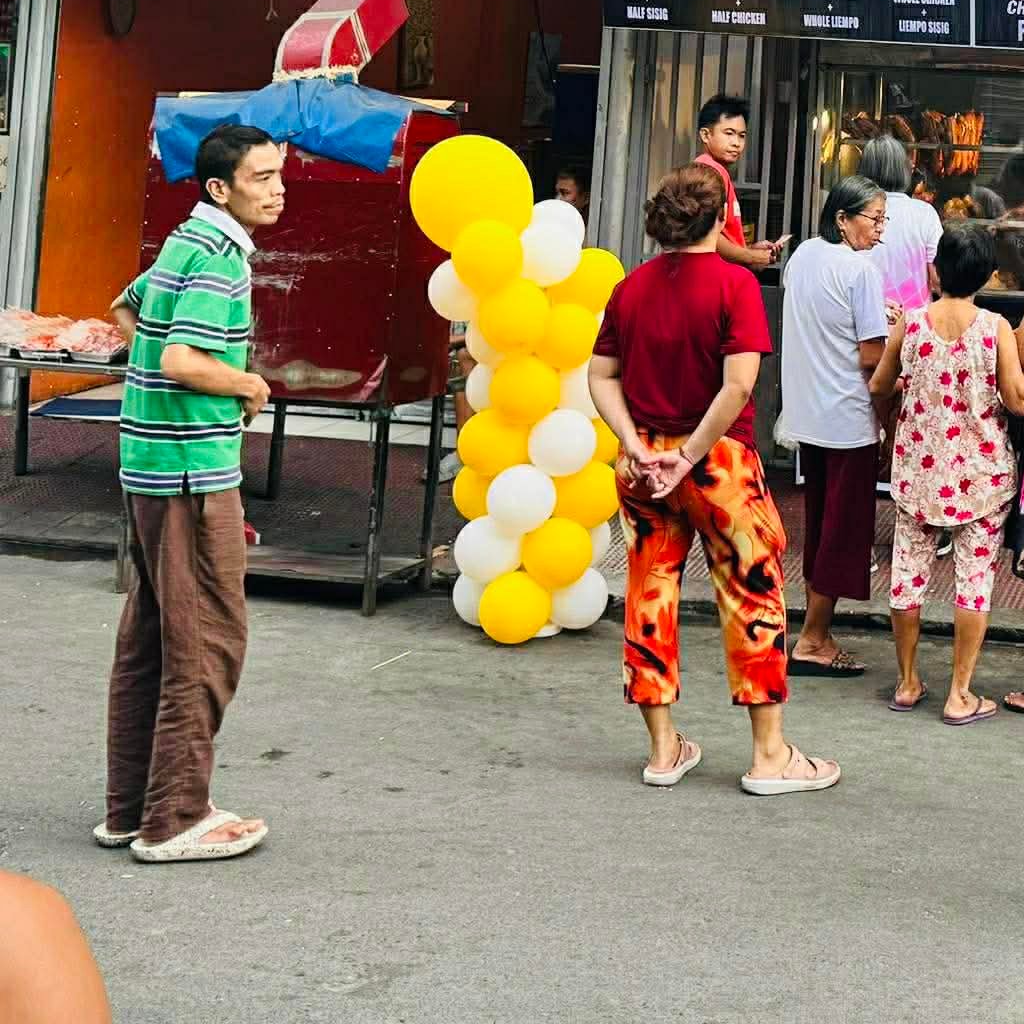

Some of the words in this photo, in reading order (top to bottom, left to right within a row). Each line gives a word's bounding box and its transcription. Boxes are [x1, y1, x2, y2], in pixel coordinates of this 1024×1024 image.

[627, 6, 645, 20] HALF
[646, 7, 668, 21] SISIG
[711, 10, 730, 24] HALF
[731, 11, 766, 25] CHICKEN
[804, 14, 830, 27] WHOLE
[831, 15, 859, 29] LIEMPO
[899, 19, 927, 33] LIEMPO
[928, 21, 950, 34] SISIG
